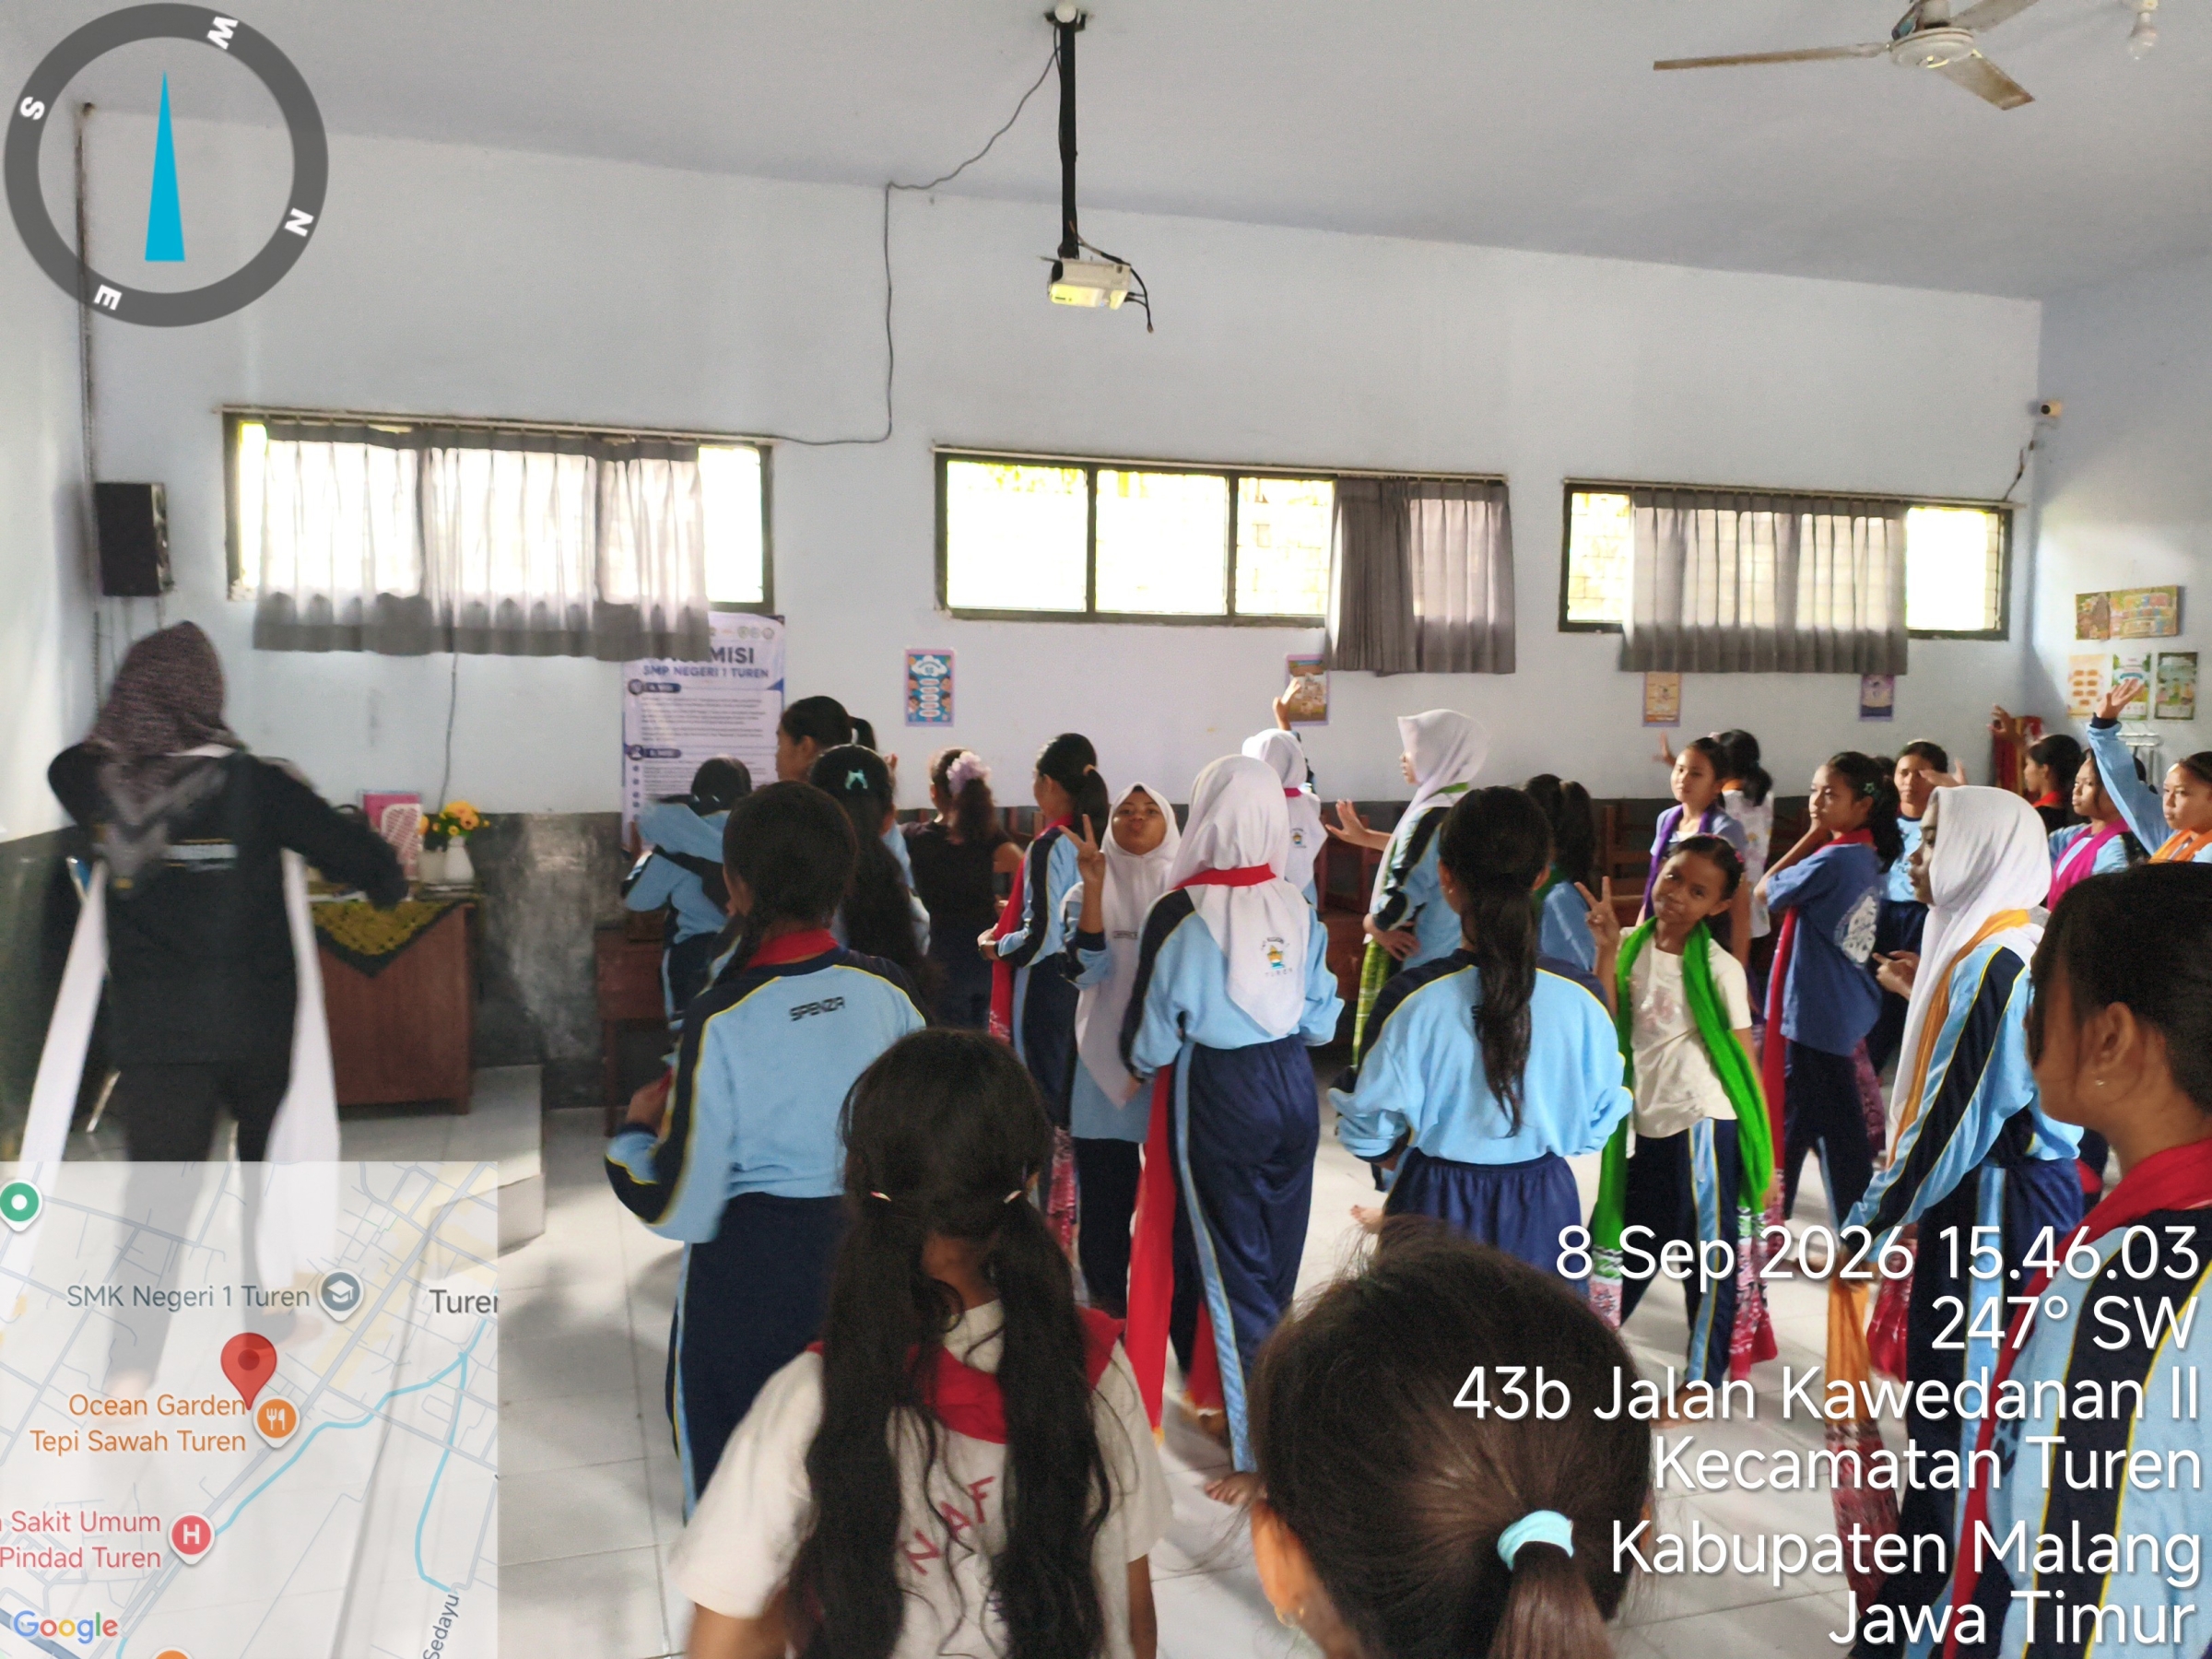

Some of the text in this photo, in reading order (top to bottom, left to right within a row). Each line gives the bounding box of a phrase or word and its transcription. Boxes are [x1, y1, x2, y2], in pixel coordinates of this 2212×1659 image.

[711, 647, 754, 664] MISI
[642, 665, 769, 678] SMP NEGERI 1 TUREN
